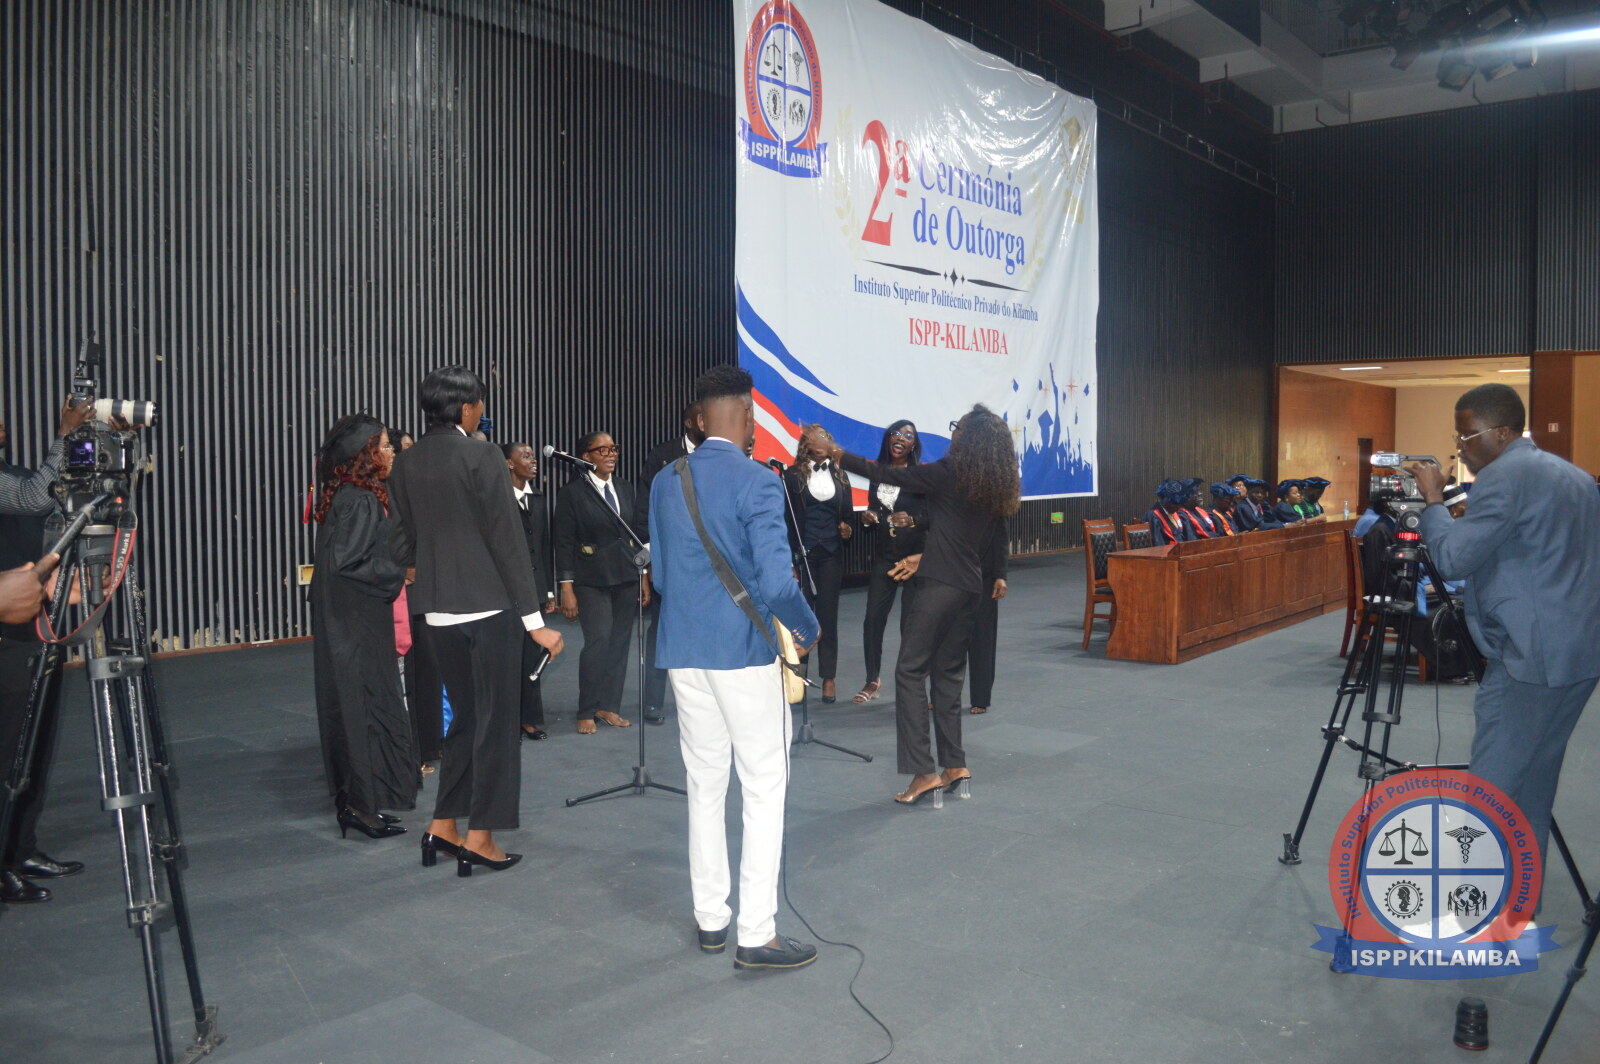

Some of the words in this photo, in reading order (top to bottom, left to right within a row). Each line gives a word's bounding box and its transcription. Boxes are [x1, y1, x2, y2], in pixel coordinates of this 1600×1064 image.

[918, 146, 1022, 216] Cerimónia
[913, 197, 939, 246] de
[946, 205, 1025, 275] Outorga
[854, 274, 891, 298] Instituto
[893, 281, 930, 306] Superior
[931, 288, 972, 311] Politécnico
[974, 295, 1000, 316] Privado
[1002, 301, 1011, 318] do
[1012, 302, 1039, 322] Kilamba
[908, 317, 1009, 355] ISPP-KILAMBA
